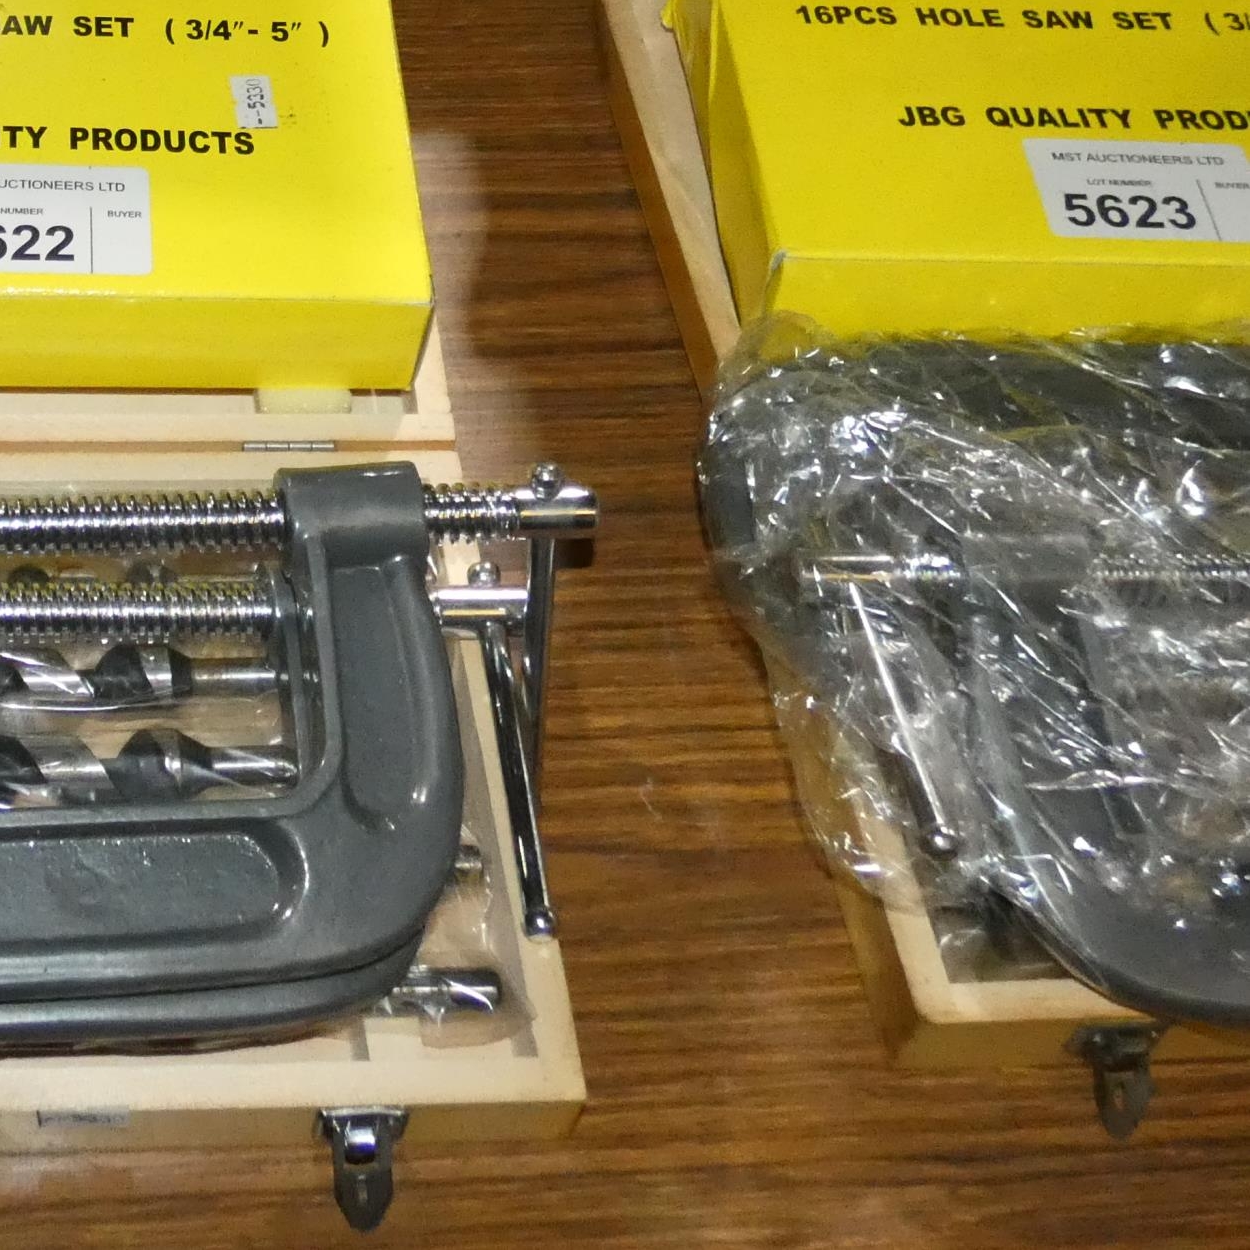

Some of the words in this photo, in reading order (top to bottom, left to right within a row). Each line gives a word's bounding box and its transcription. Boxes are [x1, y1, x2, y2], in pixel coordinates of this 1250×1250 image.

[72, 16, 134, 38] SET
[796, 5, 897, 26] 16PCS
[915, 6, 1005, 28] HOLE
[1022, 9, 1093, 30] SAW
[1113, 11, 1172, 31] SET
[898, 106, 966, 127] JBG
[986, 106, 1131, 129] QUALITY
[1153, 109, 1250, 131] PROD
[69, 126, 255, 155] PRODUCTS
[1051, 152, 1086, 163] MST
[1087, 152, 1193, 166] AUCTIONEERS
[1195, 155, 1225, 167] LTD
[98, 180, 126, 193] LTD
[1087, 178, 1105, 187] LOT
[1108, 179, 1152, 188] NUMBER
[4, 206, 44, 216] NUMBER
[106, 210, 142, 219] BUYER
[1063, 193, 1197, 230] 5623
